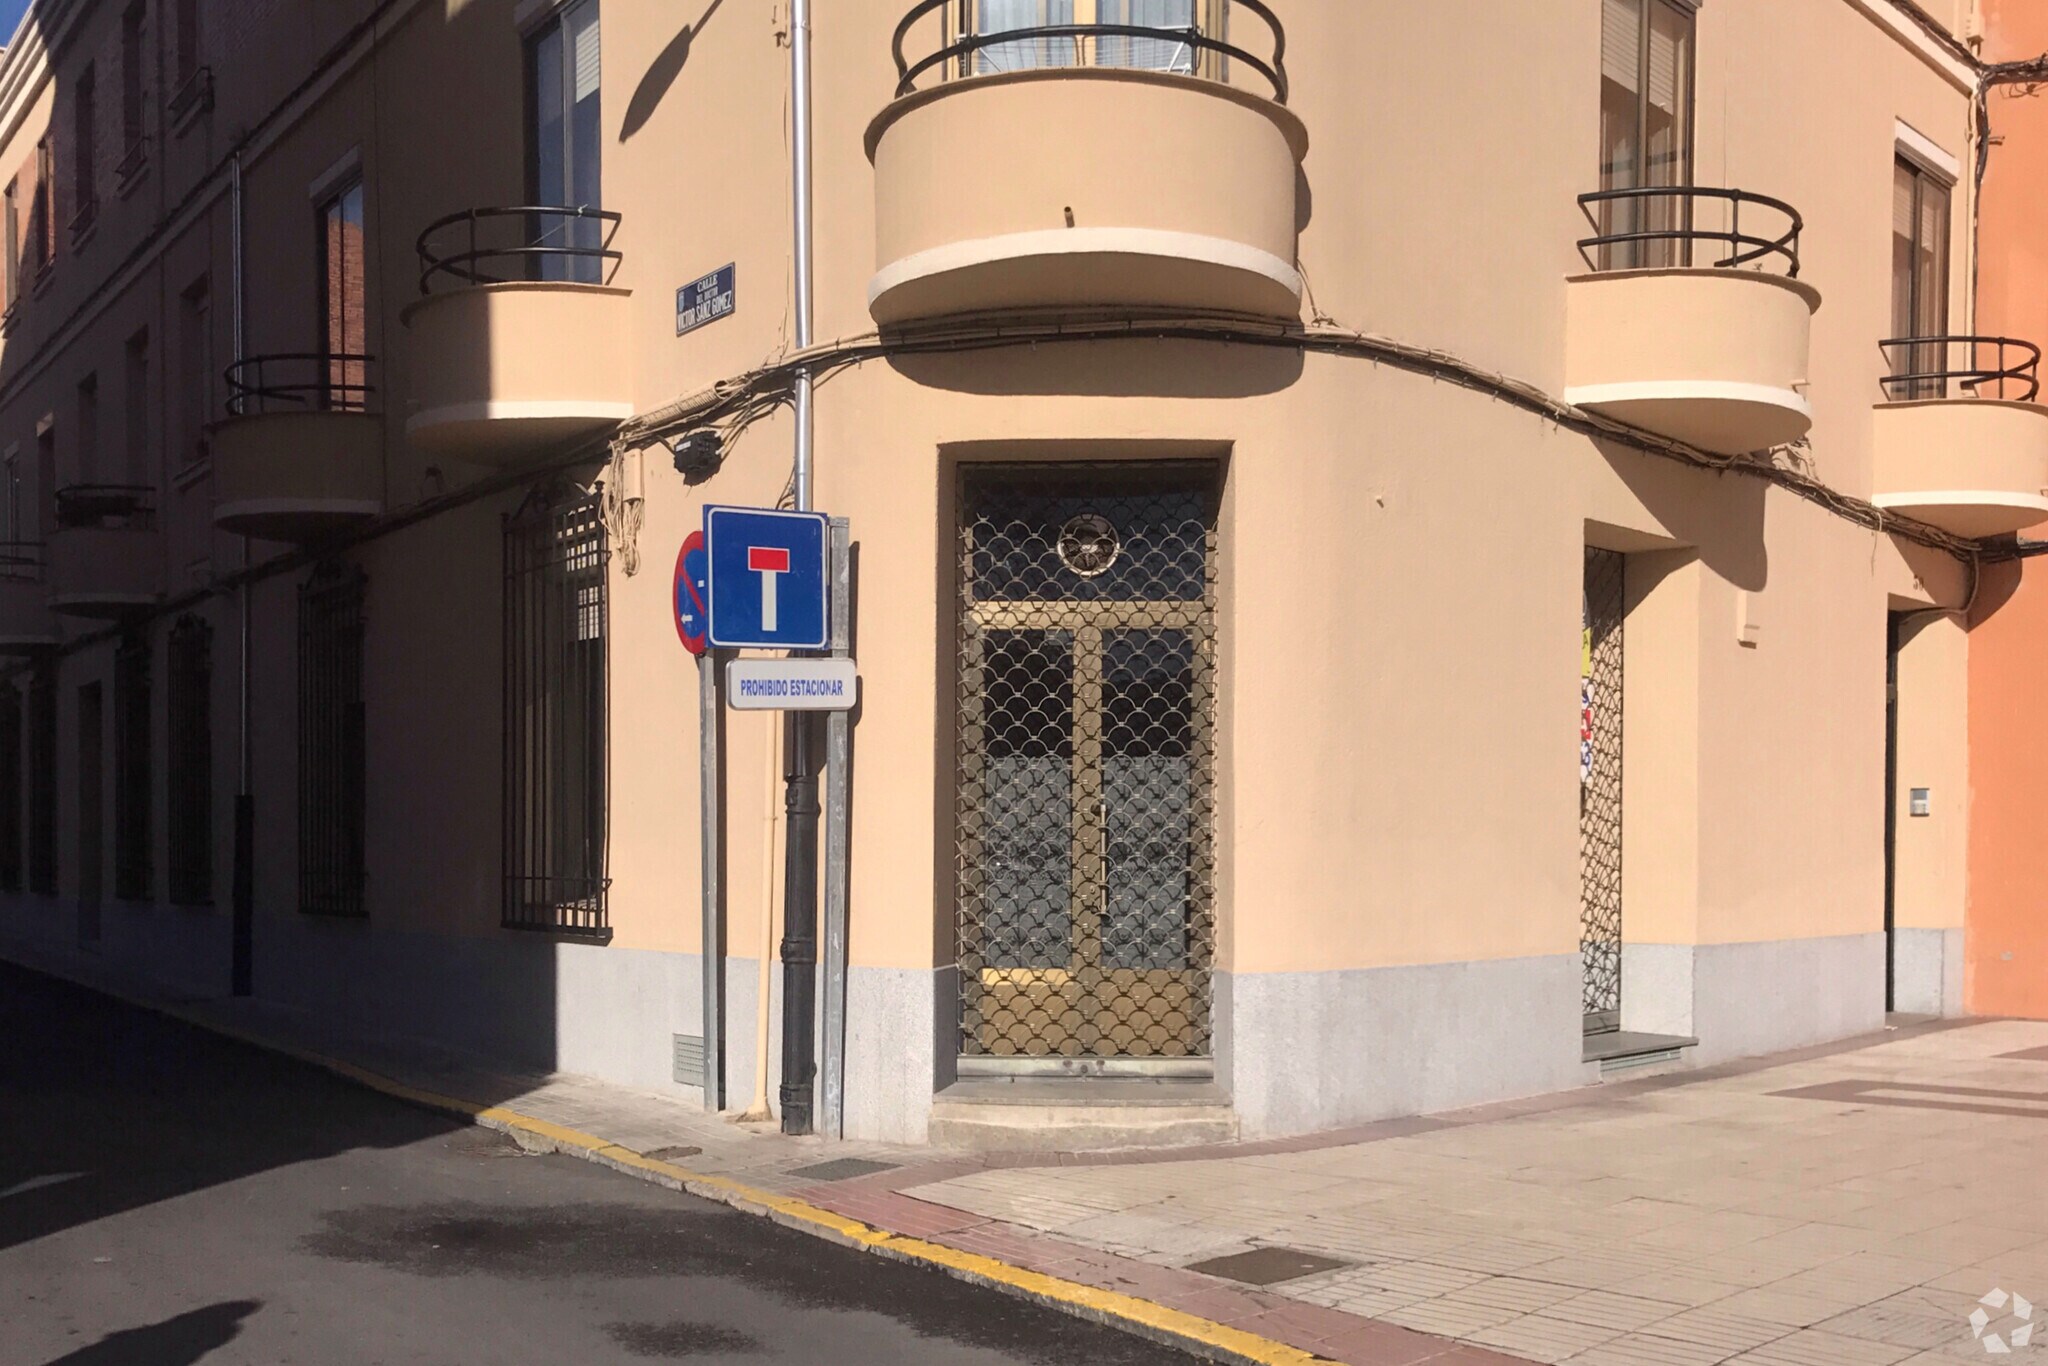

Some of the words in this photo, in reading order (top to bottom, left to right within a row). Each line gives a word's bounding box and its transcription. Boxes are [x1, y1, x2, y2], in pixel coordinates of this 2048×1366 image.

[697, 274, 718, 293] CALLE
[696, 299, 711, 322] SANZ
[740, 679, 788, 696] PROHIBIDO
[790, 679, 843, 696] ESTACIONAR
